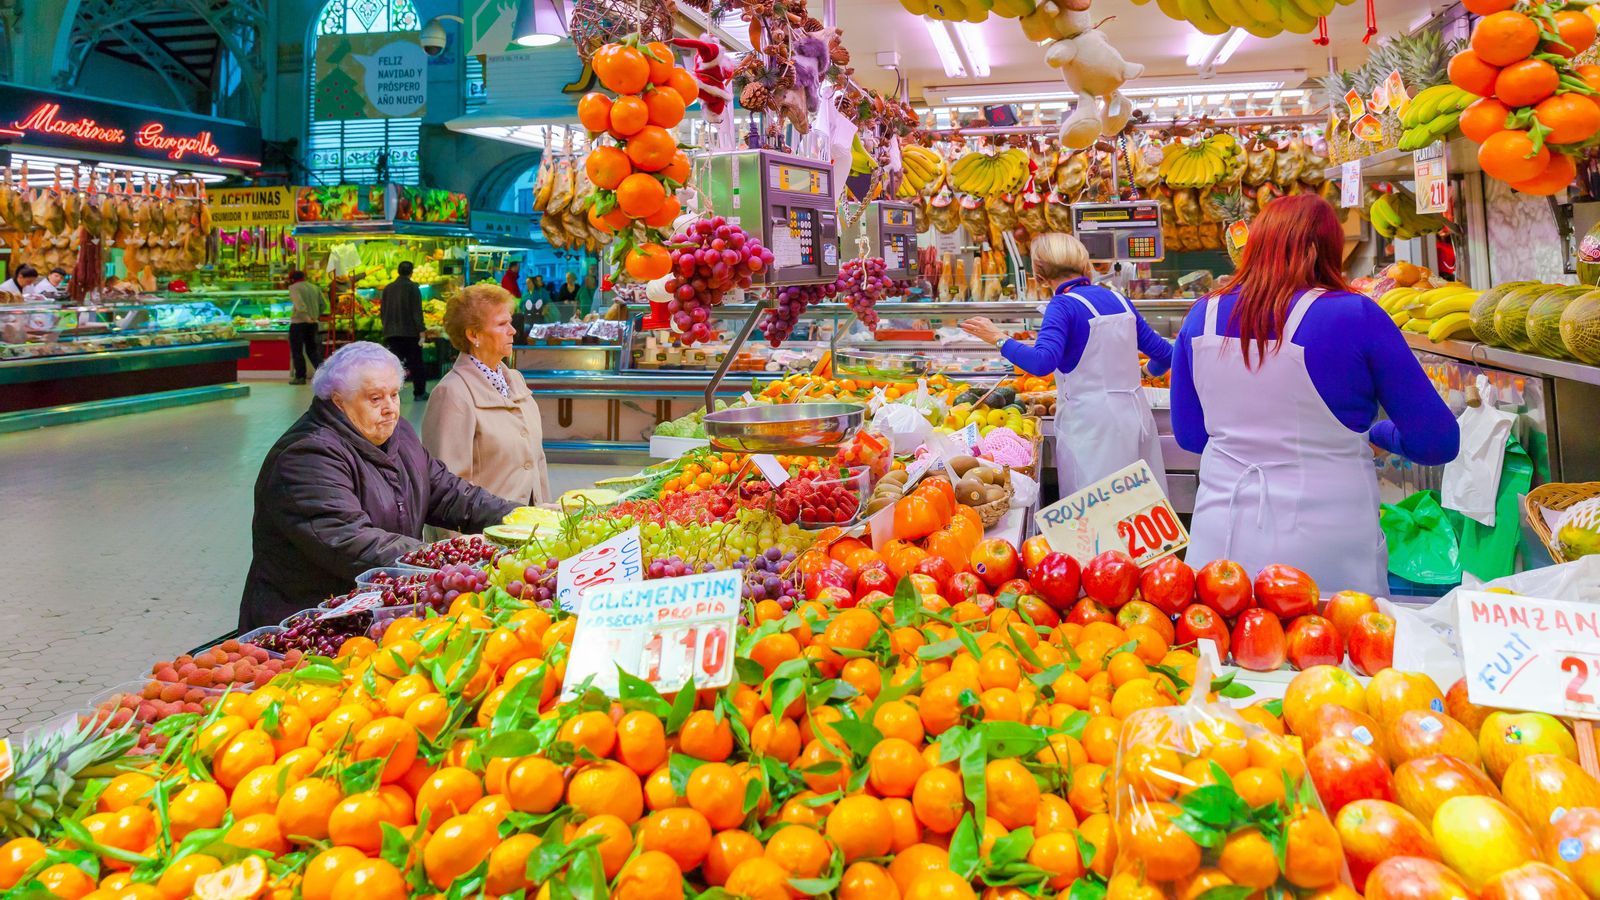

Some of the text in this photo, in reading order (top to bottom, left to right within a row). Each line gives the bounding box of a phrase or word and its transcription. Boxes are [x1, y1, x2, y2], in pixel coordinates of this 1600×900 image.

[378, 68, 423, 79] NAVIDAD Y
[379, 56, 403, 66] FELIZ
[377, 94, 424, 105] AÑO NUEVO
[378, 81, 420, 92] PRÓSPERO
[137, 123, 220, 160] Gargallo
[221, 191, 281, 206] ACEITUNAS
[252, 210, 291, 221] MAYORISTAS
[1117, 505, 1180, 559] 200
[620, 539, 640, 578] UVA
[1471, 600, 1600, 638] MANZAN
[1478, 631, 1532, 691] FUJI
[1561, 656, 1600, 704] 2
